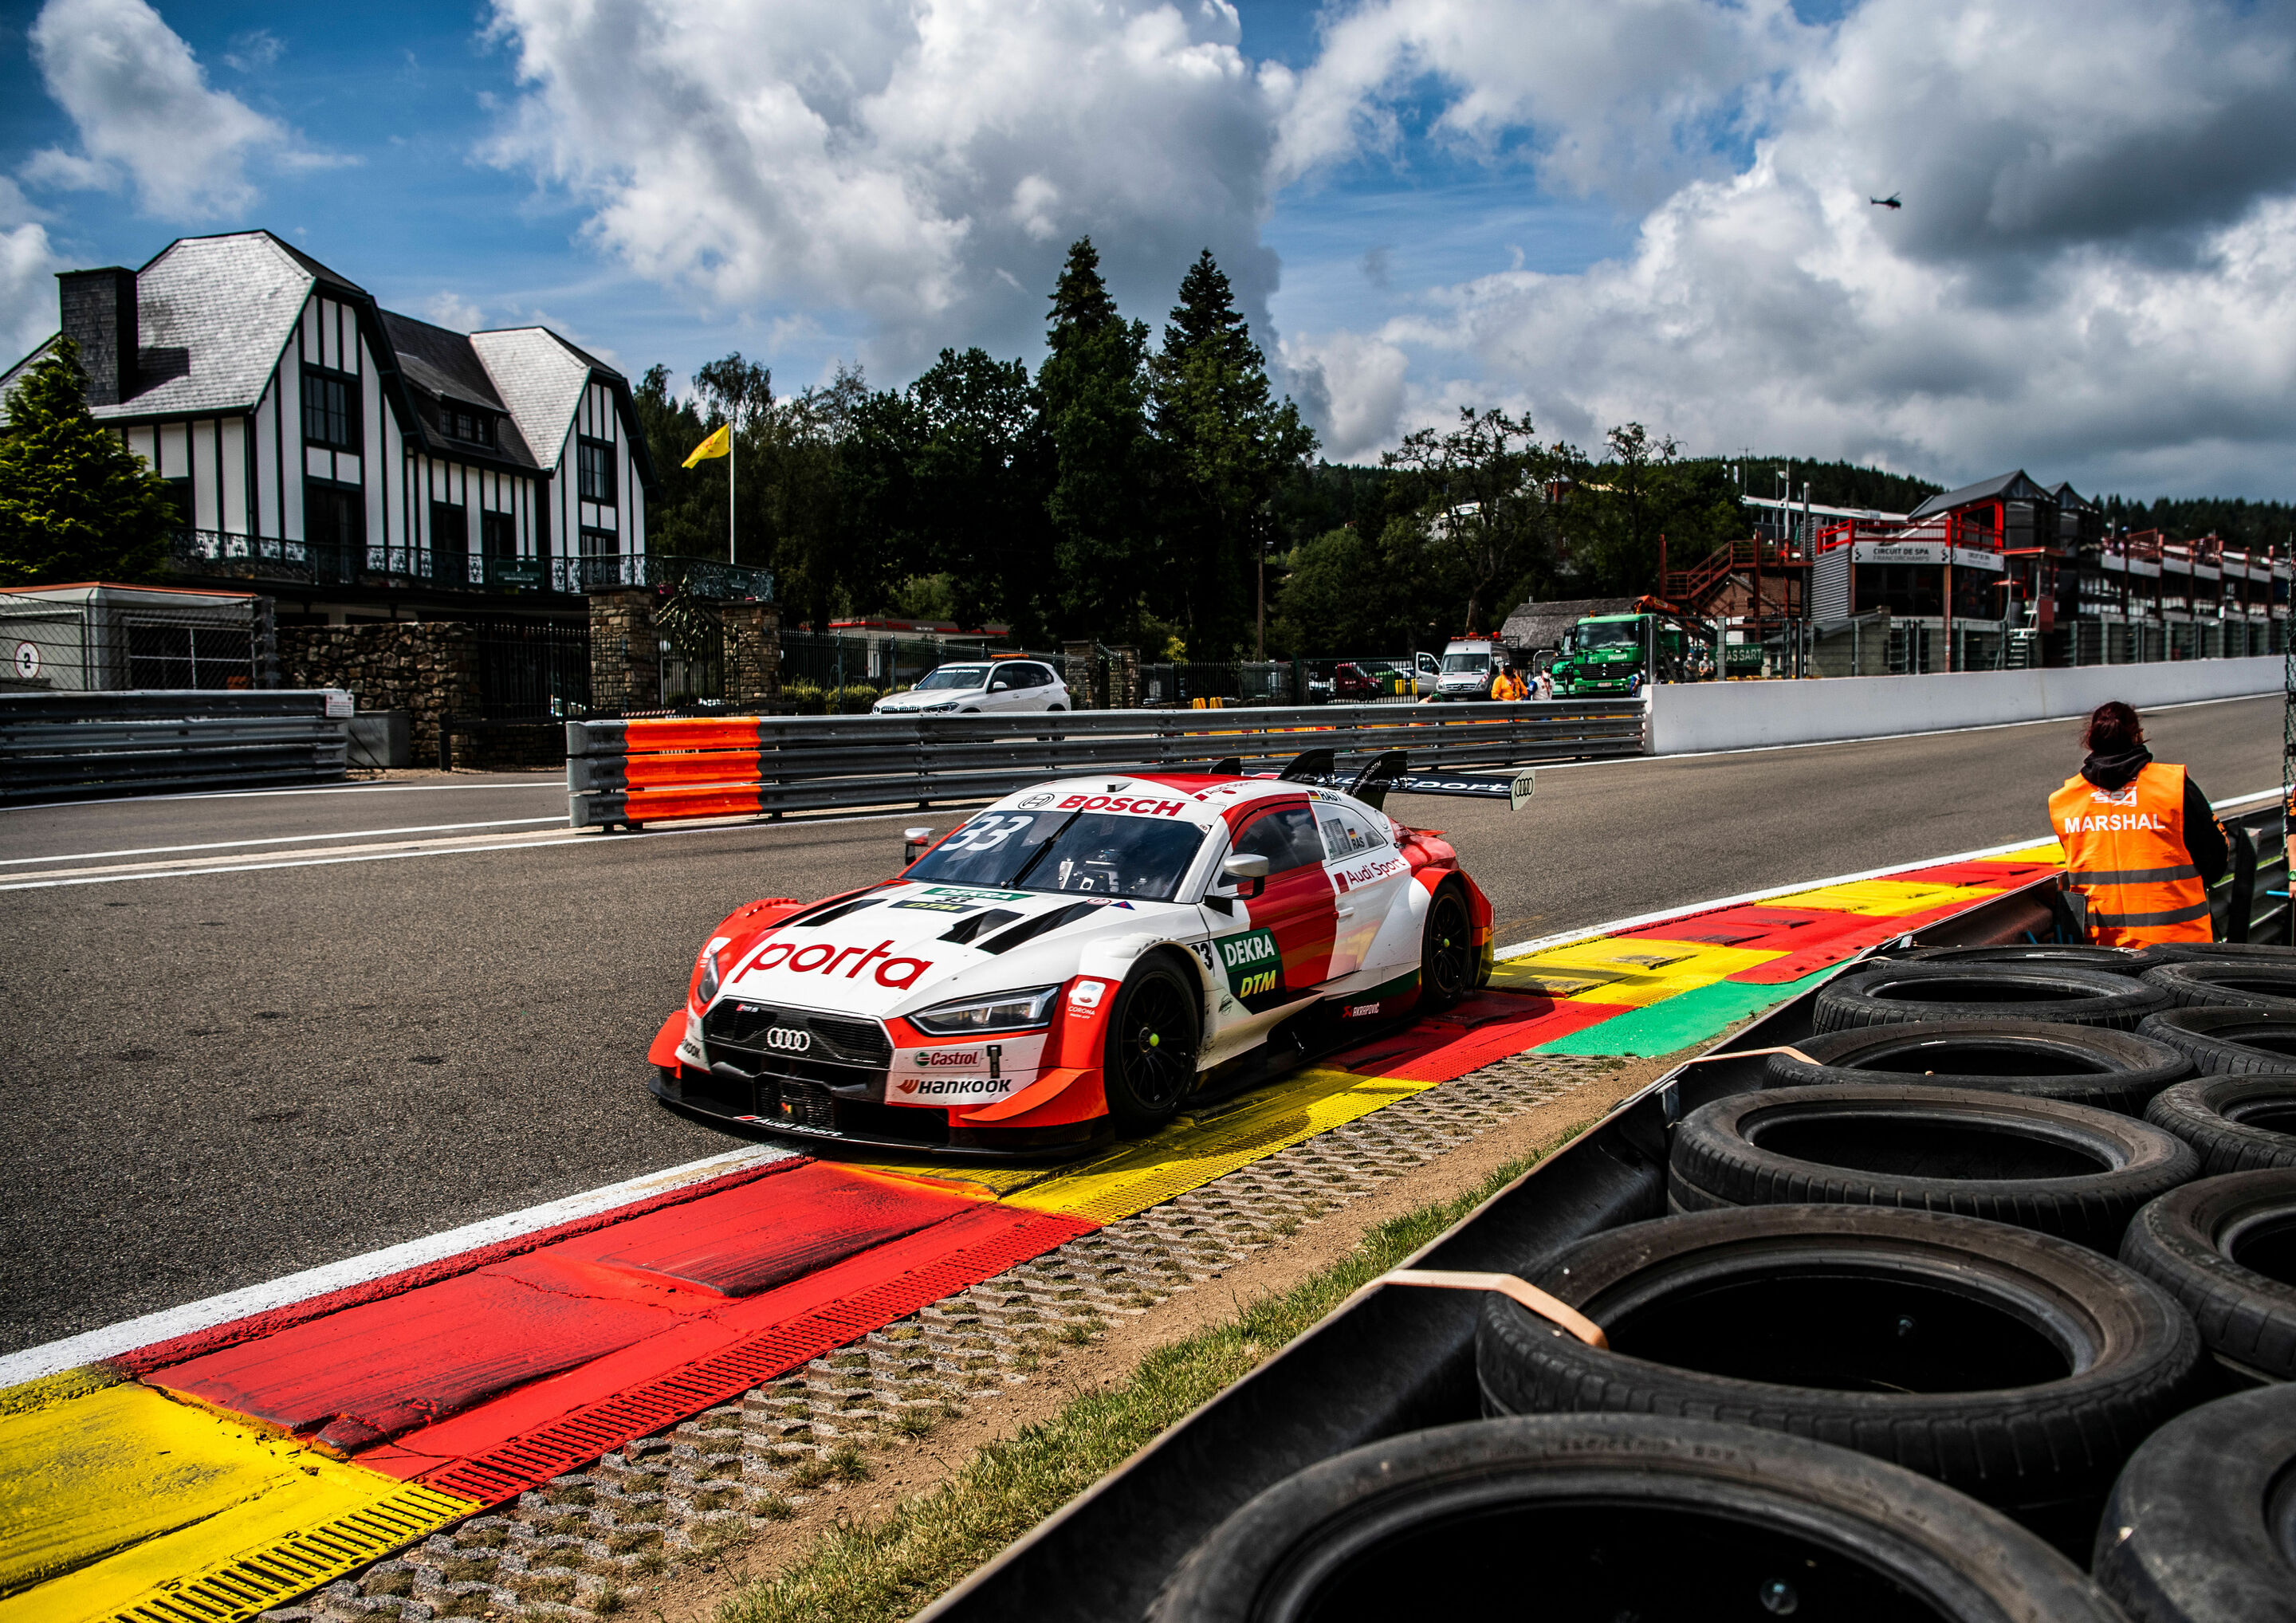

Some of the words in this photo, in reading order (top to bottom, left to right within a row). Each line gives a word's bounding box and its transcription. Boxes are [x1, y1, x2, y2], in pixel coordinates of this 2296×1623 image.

[24, 652, 31, 670] 2
[1056, 795, 1186, 817] BOSCH
[938, 815, 1034, 851] 33
[2064, 813, 2166, 834] MARSHAL
[1346, 865, 1375, 885] Audi
[1370, 858, 1406, 878] Sport
[935, 889, 1013, 900] DEKRA
[904, 902, 964, 911] DTM
[1224, 934, 1276, 967] DEKRA
[732, 940, 934, 991] porta
[1240, 969, 1276, 999] DTM
[1068, 1006, 1095, 1016] CORONA
[930, 1051, 978, 1066] Castrol
[918, 1079, 1012, 1094] HANKOOK
[753, 1118, 792, 1129] Audi
[791, 1125, 843, 1137] Sport
